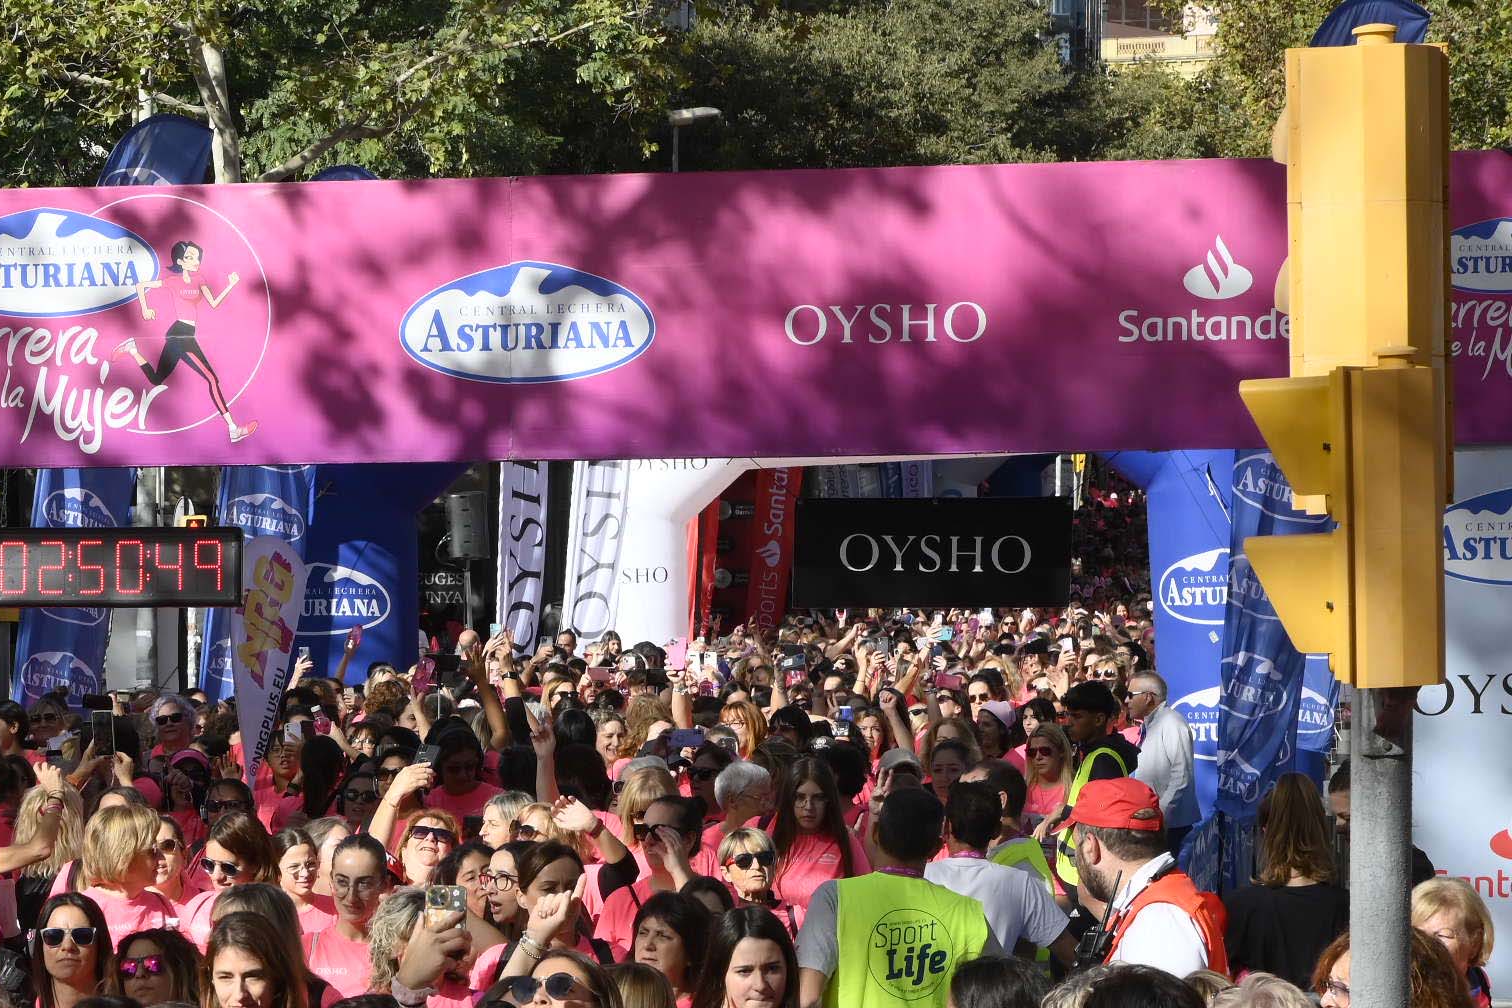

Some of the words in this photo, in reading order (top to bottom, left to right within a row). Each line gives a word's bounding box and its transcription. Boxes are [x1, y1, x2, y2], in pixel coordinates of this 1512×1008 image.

[418, 308, 635, 353] ASTURIANA
[459, 304, 526, 316] CENTRAL
[546, 302, 628, 315] LECHERA
[784, 301, 988, 346] OYSHO
[0, 369, 25, 408] la
[20, 360, 169, 454] Mujer
[0, 540, 222, 595] 02:50:49
[622, 566, 668, 584] SHO
[839, 533, 1032, 574] OYSHO
[424, 591, 465, 604] NYA
[759, 572, 778, 631] ports
[249, 667, 287, 777] @NRGPLUS.EU
[875, 919, 937, 951] Sport
[886, 943, 947, 986] Life
